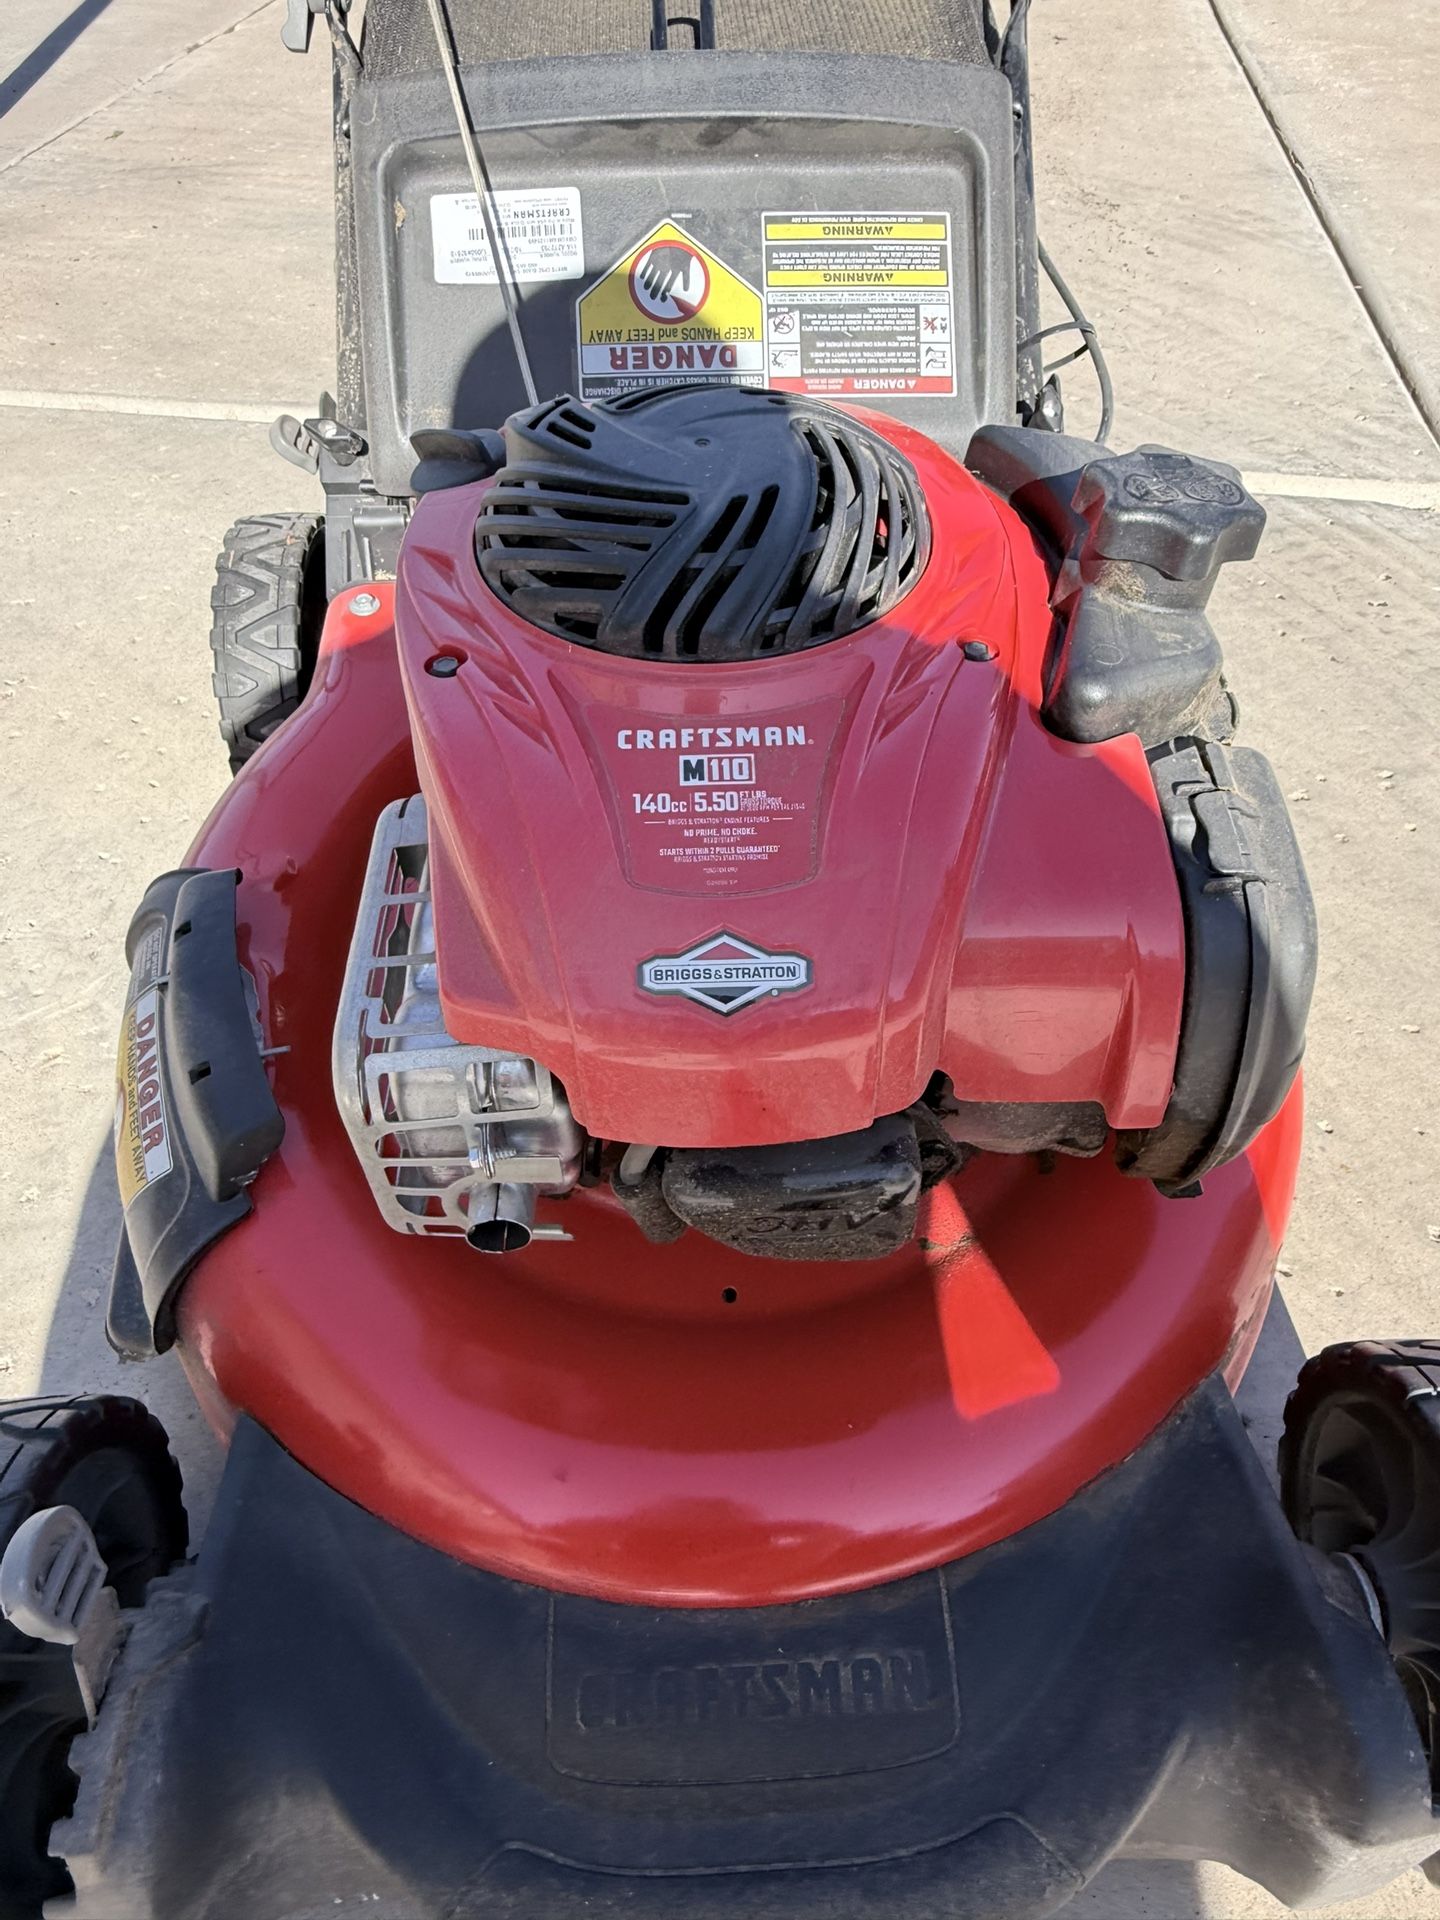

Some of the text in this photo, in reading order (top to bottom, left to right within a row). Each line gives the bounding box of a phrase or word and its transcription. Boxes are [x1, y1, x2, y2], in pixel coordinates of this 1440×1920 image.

[513, 208, 570, 218] CRAFTSMAN
[822, 226, 883, 235] WARNING
[823, 273, 885, 282] WARNING
[588, 327, 754, 342] KEEP HANDS and FEET AWAY
[609, 344, 738, 370] DANGER
[853, 379, 905, 389] DANGER
[617, 726, 807, 750] CRAFTSMAN
[683, 757, 749, 782] M110
[694, 791, 739, 812] 5.50
[752, 790, 766, 798] LBS
[684, 829, 694, 837] NO
[721, 828, 731, 836] NO
[732, 827, 757, 835] CHOKE.
[127, 1044, 137, 1084] HANDS
[136, 1012, 164, 1155] DANGER
[128, 1088, 137, 1109] and
[129, 1112, 140, 1142] FEET
[131, 1146, 146, 1184] AWAY
[575, 1649, 934, 1733] CRAFTSMAN
